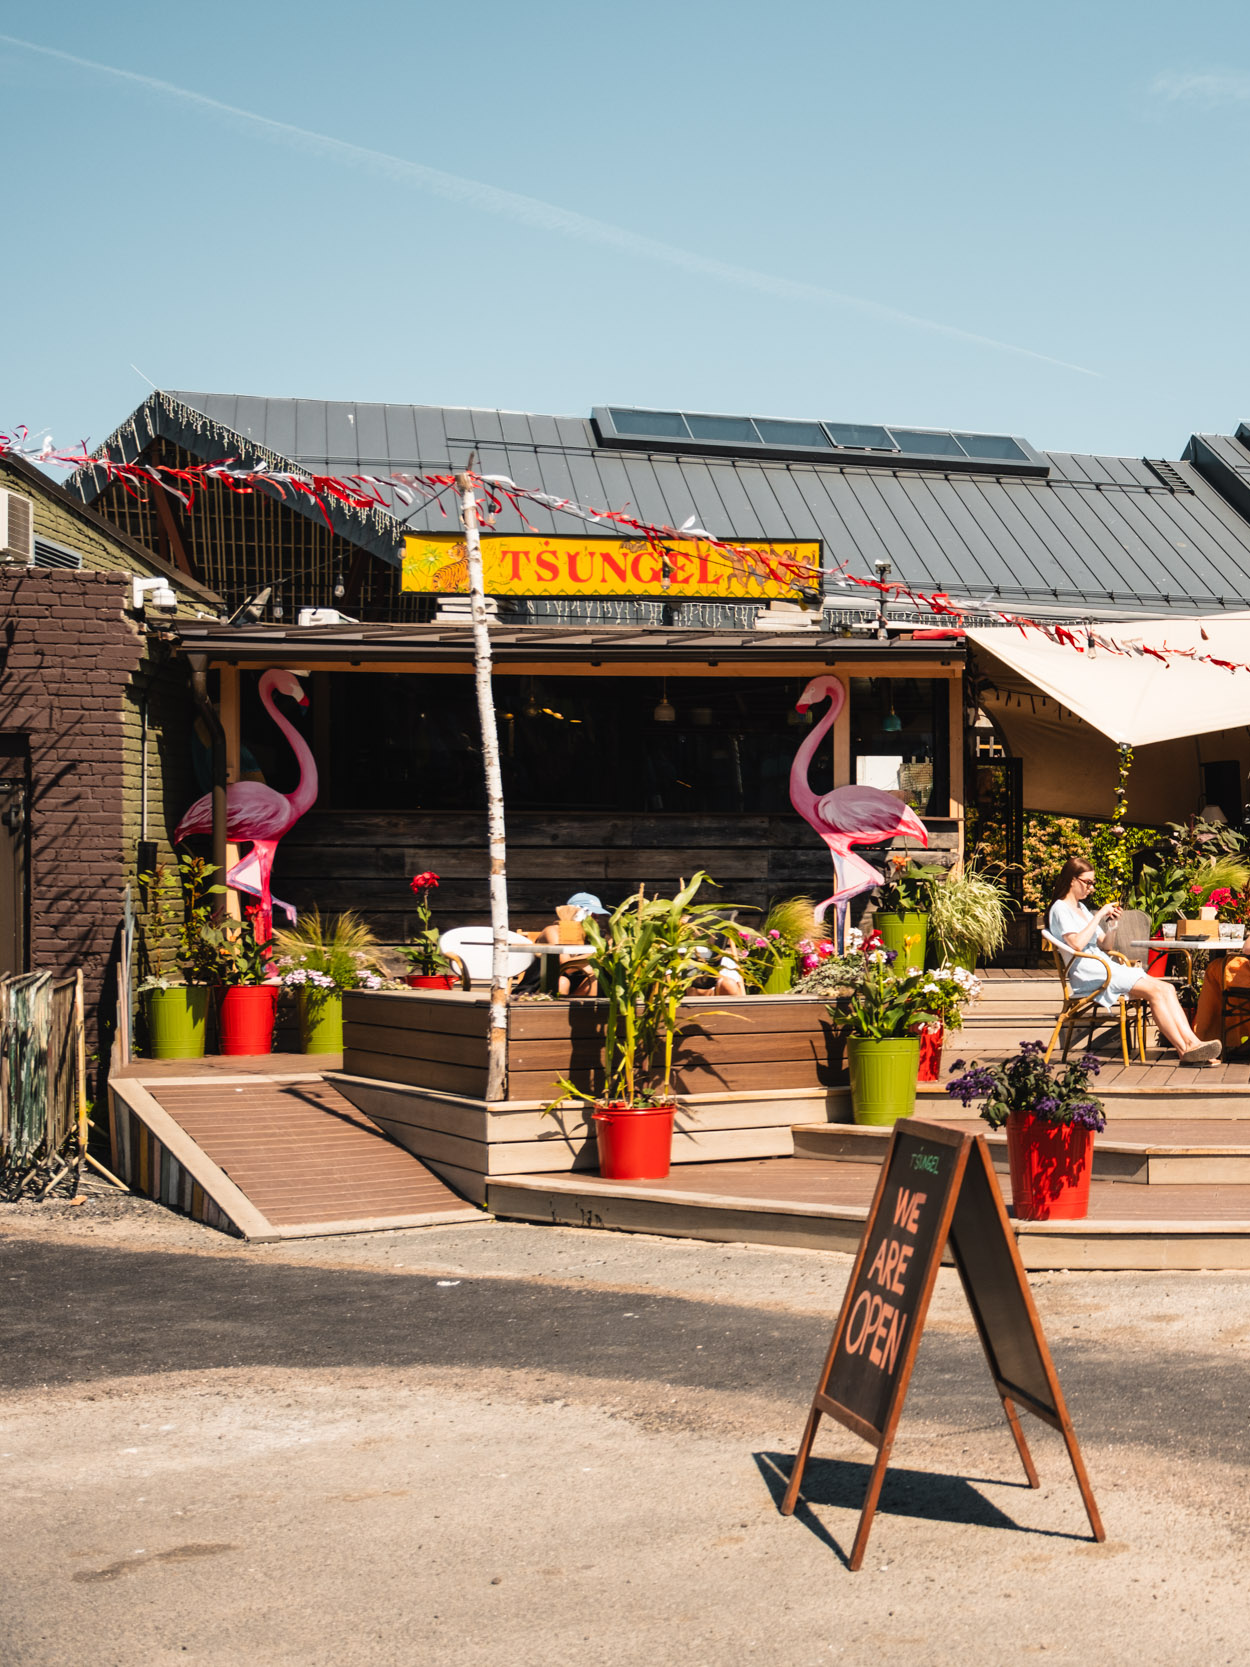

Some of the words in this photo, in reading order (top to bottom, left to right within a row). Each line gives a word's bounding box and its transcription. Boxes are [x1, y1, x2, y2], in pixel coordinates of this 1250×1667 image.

[893, 1186, 928, 1235] WE
[867, 1238, 915, 1296] ARE
[845, 1290, 908, 1376] OPEN
